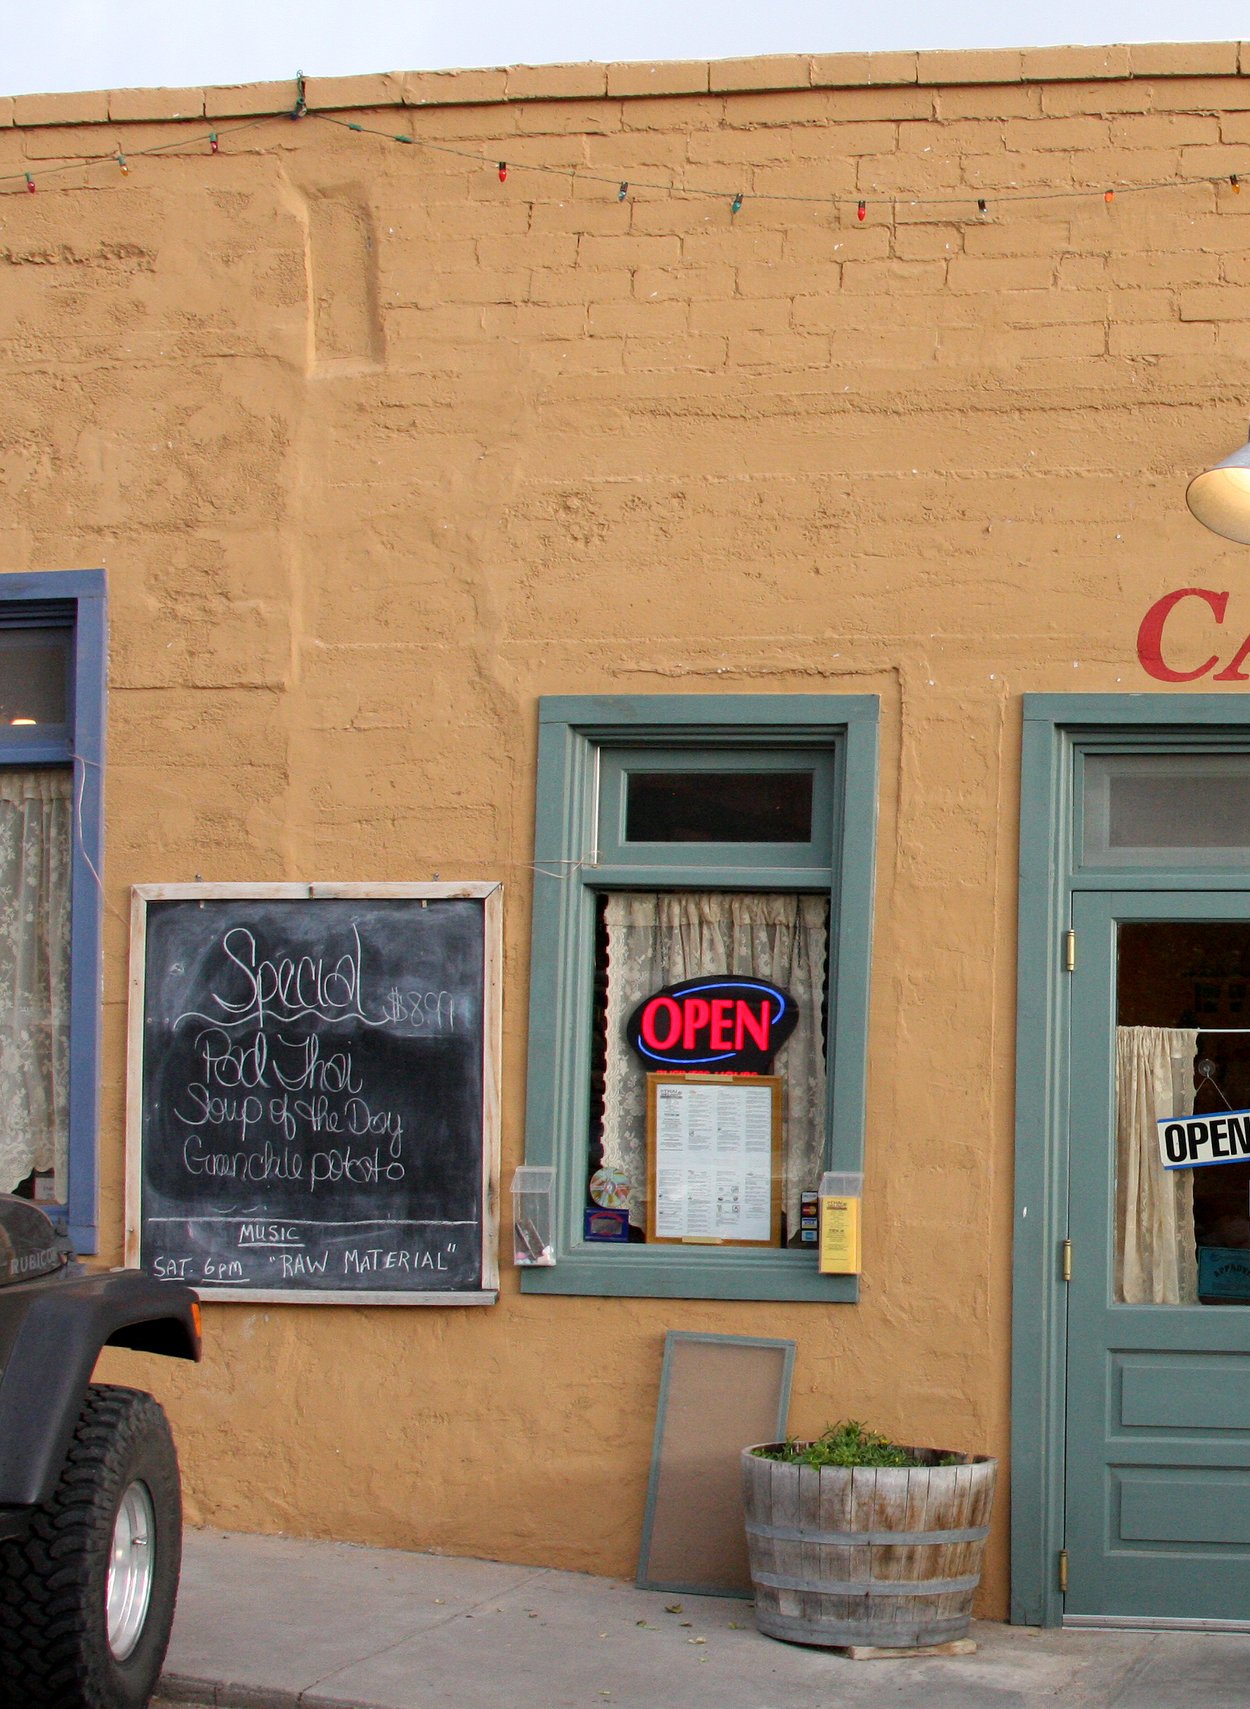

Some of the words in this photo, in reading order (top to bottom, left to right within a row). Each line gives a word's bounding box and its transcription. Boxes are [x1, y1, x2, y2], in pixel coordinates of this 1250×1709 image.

[212, 923, 366, 1028] Special
[641, 996, 770, 1051] OPEN
[273, 1033, 363, 1094] Thai
[174, 1082, 263, 1142] Soup
[270, 1093, 296, 1140] of
[294, 1095, 345, 1134] the
[344, 1097, 404, 1158] Day
[238, 1224, 300, 1243] MUSIC
